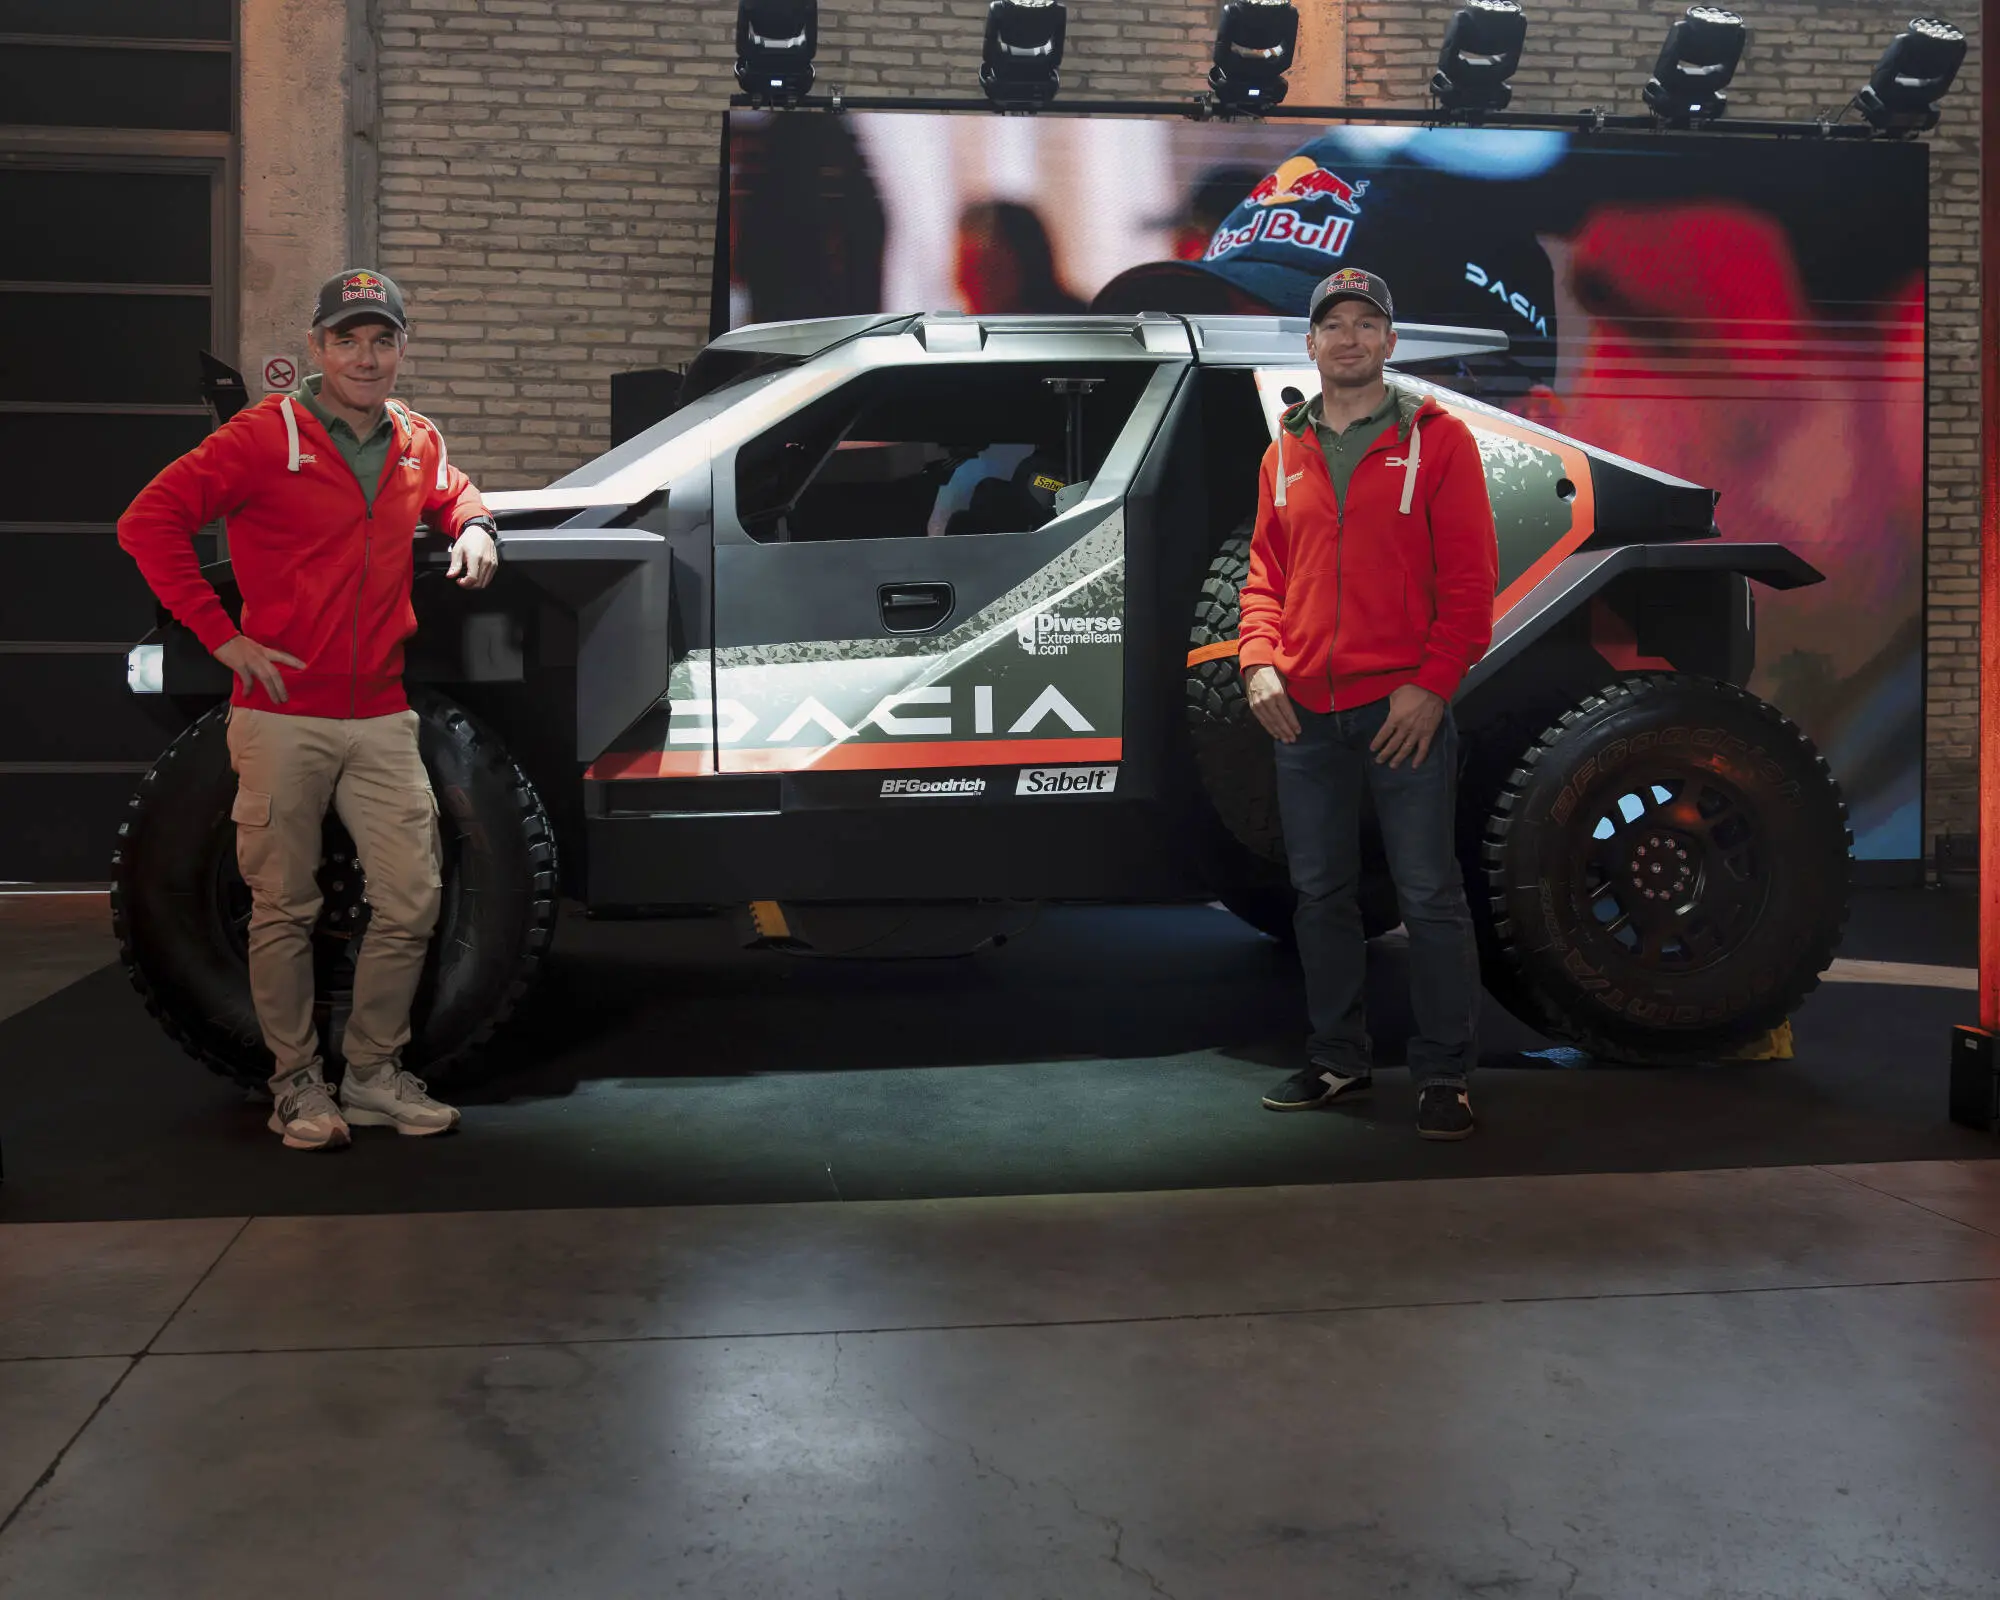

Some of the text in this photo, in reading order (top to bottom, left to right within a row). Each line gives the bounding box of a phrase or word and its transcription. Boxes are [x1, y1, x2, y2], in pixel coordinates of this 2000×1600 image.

[1261, 209, 1354, 257] Bull
[1347, 281, 1369, 292] Bull
[342, 288, 388, 304] Red Bull
[1465, 262, 1547, 338] DACIA
[1038, 613, 1122, 631] Diverse
[1038, 631, 1122, 644] ExtremeTeam
[1037, 645, 1068, 655] .com
[669, 683, 1096, 744] DACIA
[881, 778, 986, 793] BFGoodrich
[1026, 770, 1108, 793] Sabelt
